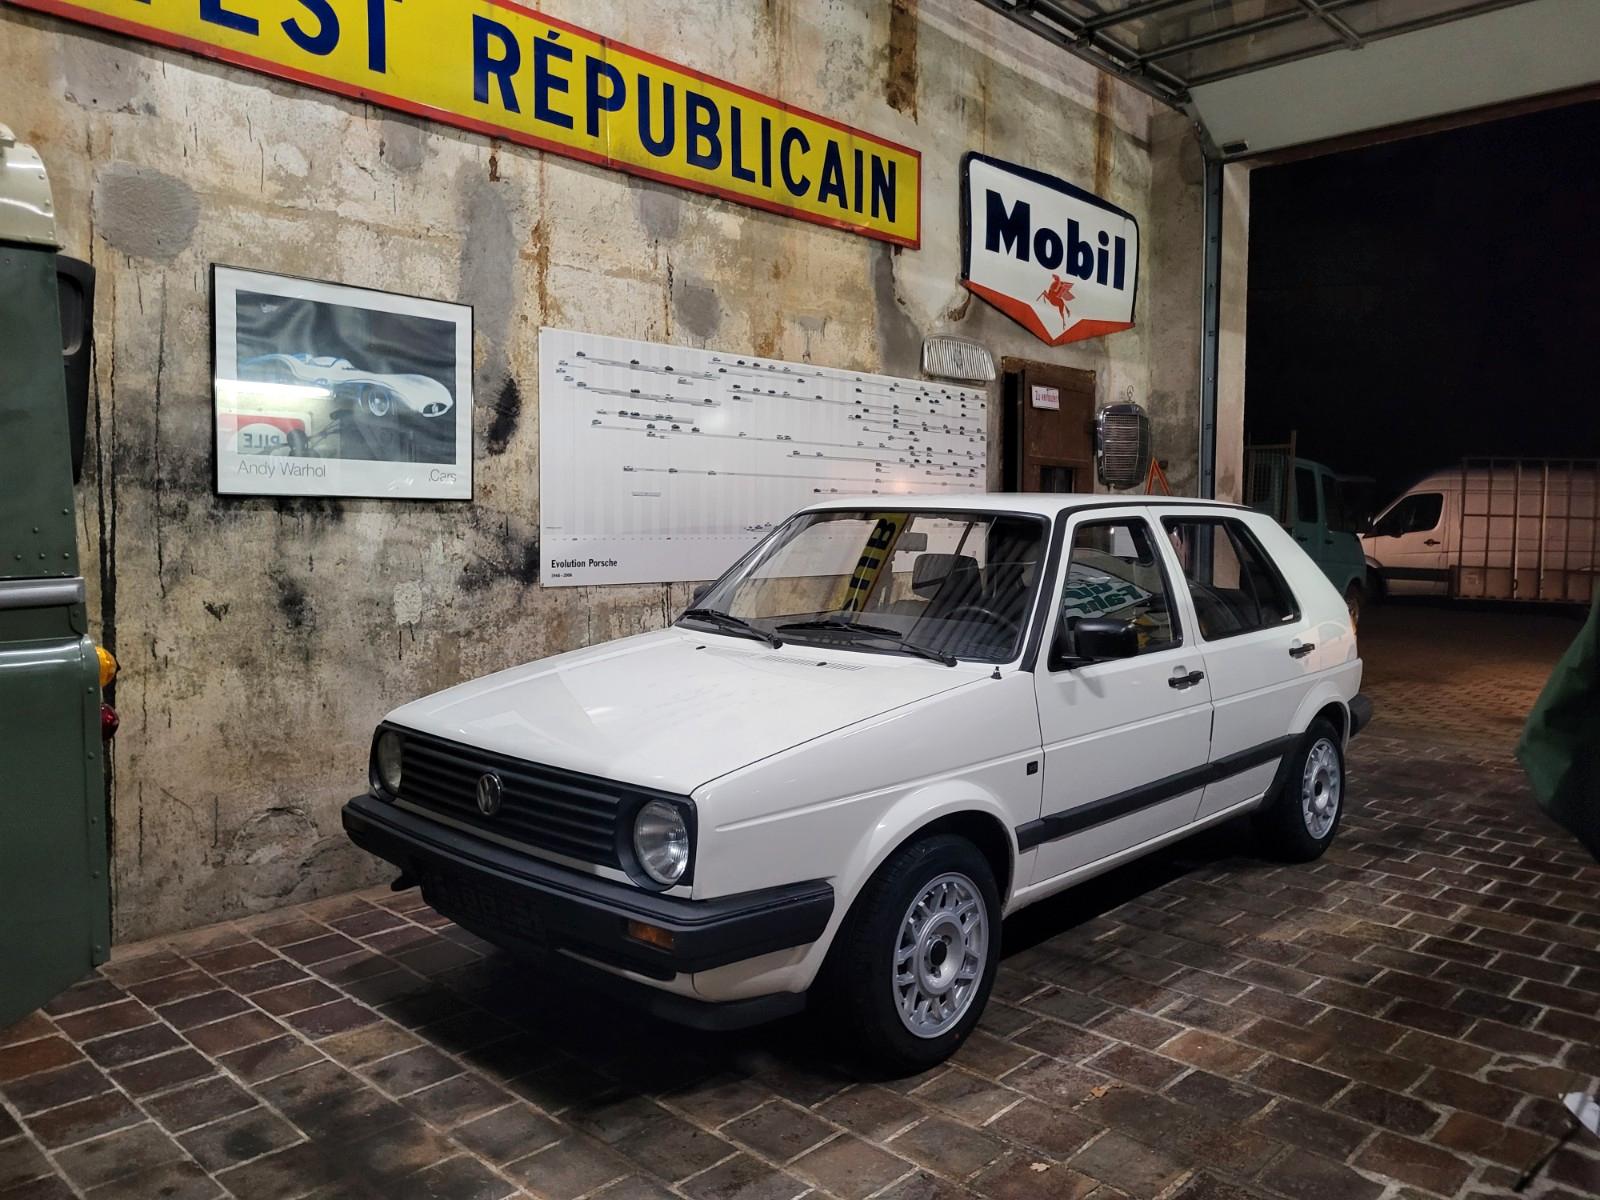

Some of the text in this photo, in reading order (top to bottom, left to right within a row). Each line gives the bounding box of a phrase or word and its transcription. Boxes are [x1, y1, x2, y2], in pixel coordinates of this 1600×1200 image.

[471, 13, 897, 223] RÉPUBLICAIN
[985, 188, 1126, 291] Mobil
[238, 459, 326, 479] Andy Warhol
[430, 468, 457, 482] Cars
[551, 558, 617, 568] Evolution Porsche
